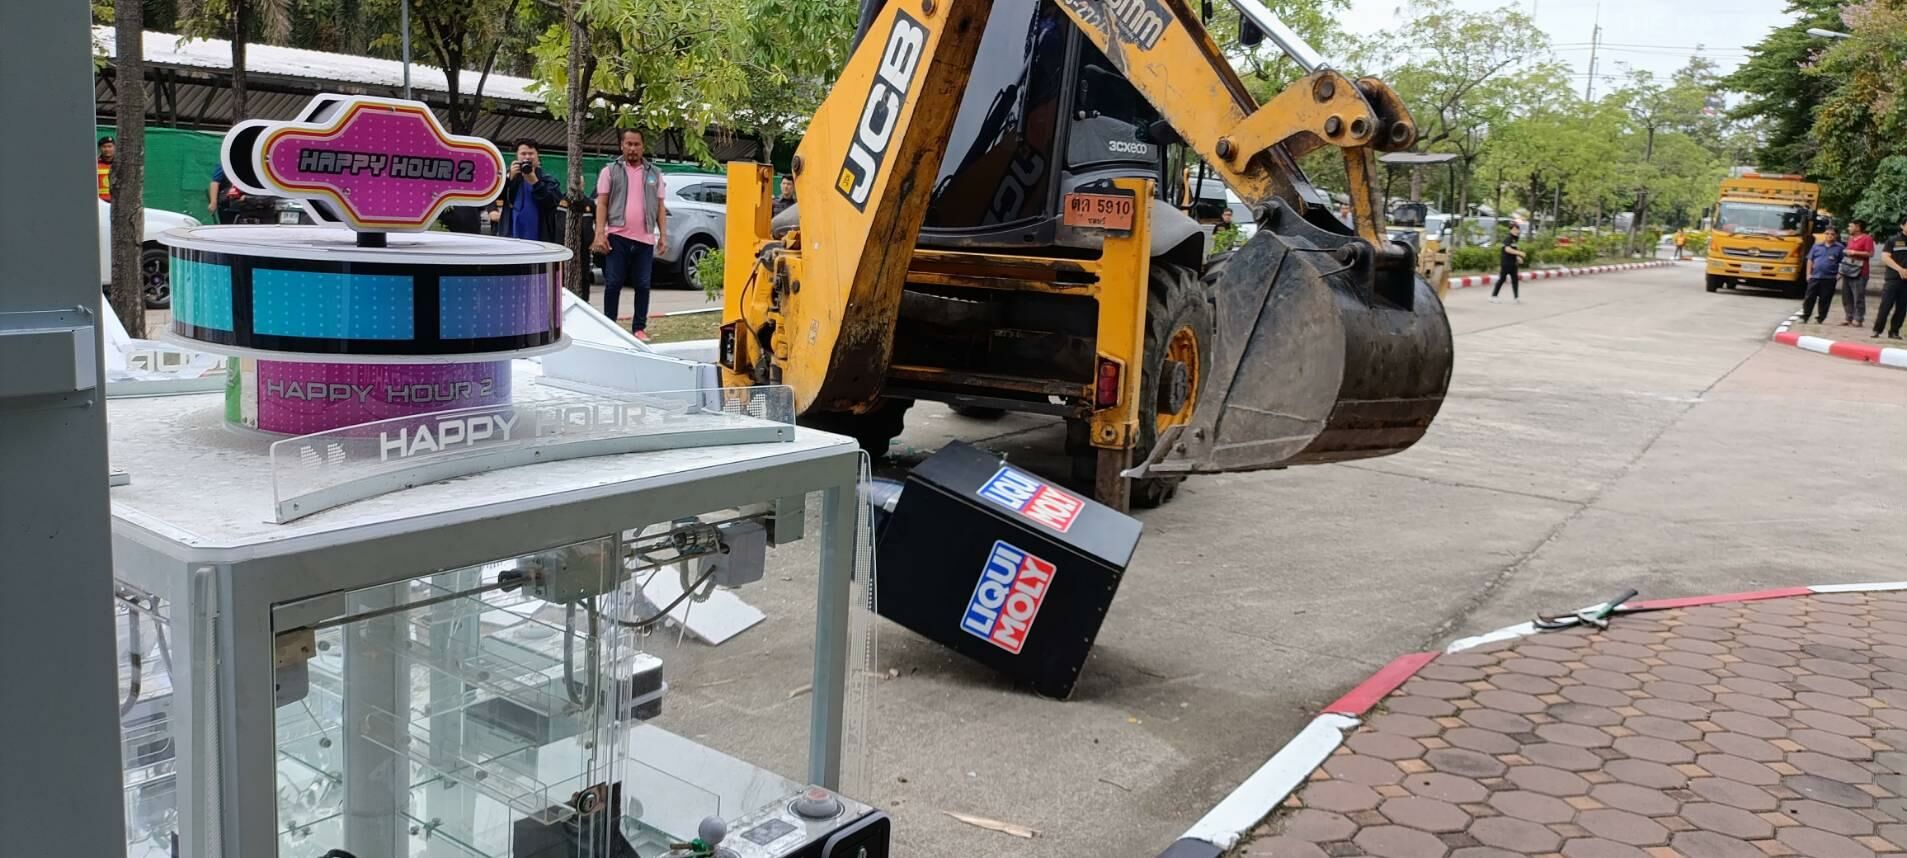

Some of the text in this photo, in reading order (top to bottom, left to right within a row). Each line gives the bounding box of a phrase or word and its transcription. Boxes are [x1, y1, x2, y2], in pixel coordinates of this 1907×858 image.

[849, 19, 924, 204] JCB
[300, 149, 475, 182] HAPPY HOUR 2
[1097, 200, 1130, 215] 5910
[267, 378, 493, 404] HAPPY HOUR 2
[380, 414, 519, 462] HAPPY
[536, 401, 648, 437] HOUR
[983, 470, 1040, 510] LIQUI
[1026, 485, 1079, 529] MOLY
[964, 546, 1025, 635] LIQUI
[993, 557, 1050, 648] MOLY
